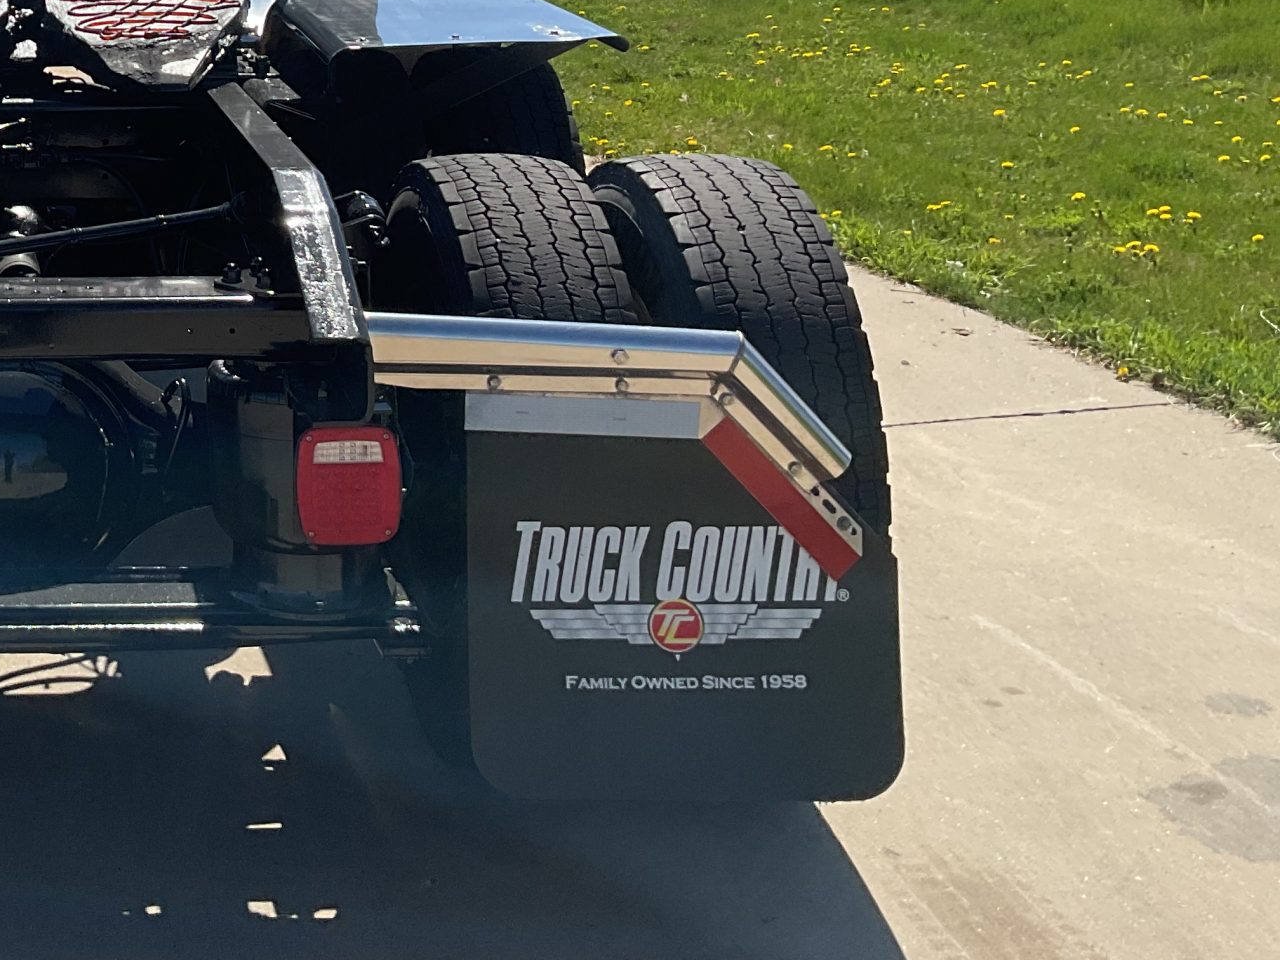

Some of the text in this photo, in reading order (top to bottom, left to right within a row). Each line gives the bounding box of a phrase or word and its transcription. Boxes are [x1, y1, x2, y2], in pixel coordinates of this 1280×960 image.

[511, 521, 651, 603] TRUCK
[565, 674, 807, 689] FAMILY OWNED SINCE 1958
